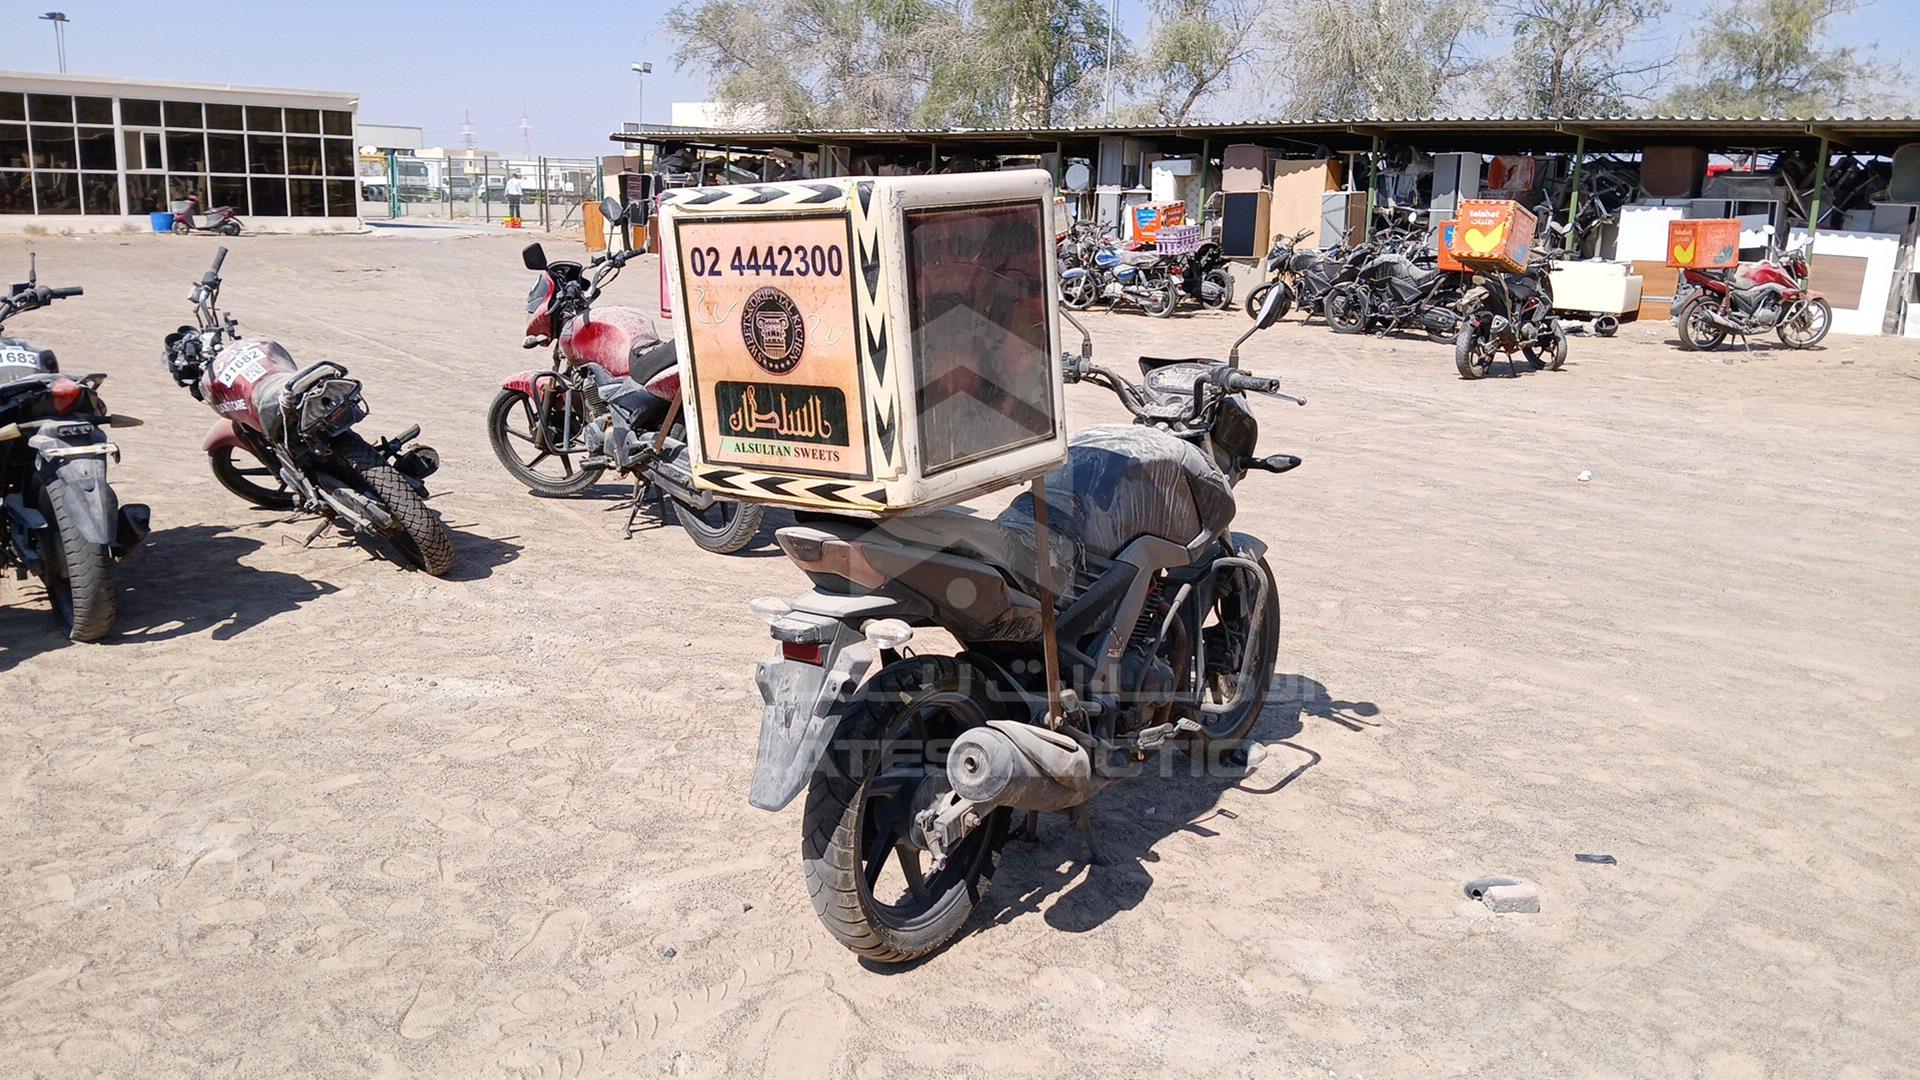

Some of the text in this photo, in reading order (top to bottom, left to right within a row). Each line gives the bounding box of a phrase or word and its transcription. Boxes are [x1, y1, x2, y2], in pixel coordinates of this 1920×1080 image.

[1469, 210, 1499, 218] talabat
[690, 245, 843, 277] 02 4442300
[729, 385, 832, 439] السلطان
[734, 442, 840, 462] ALSULTAN SWEETS
